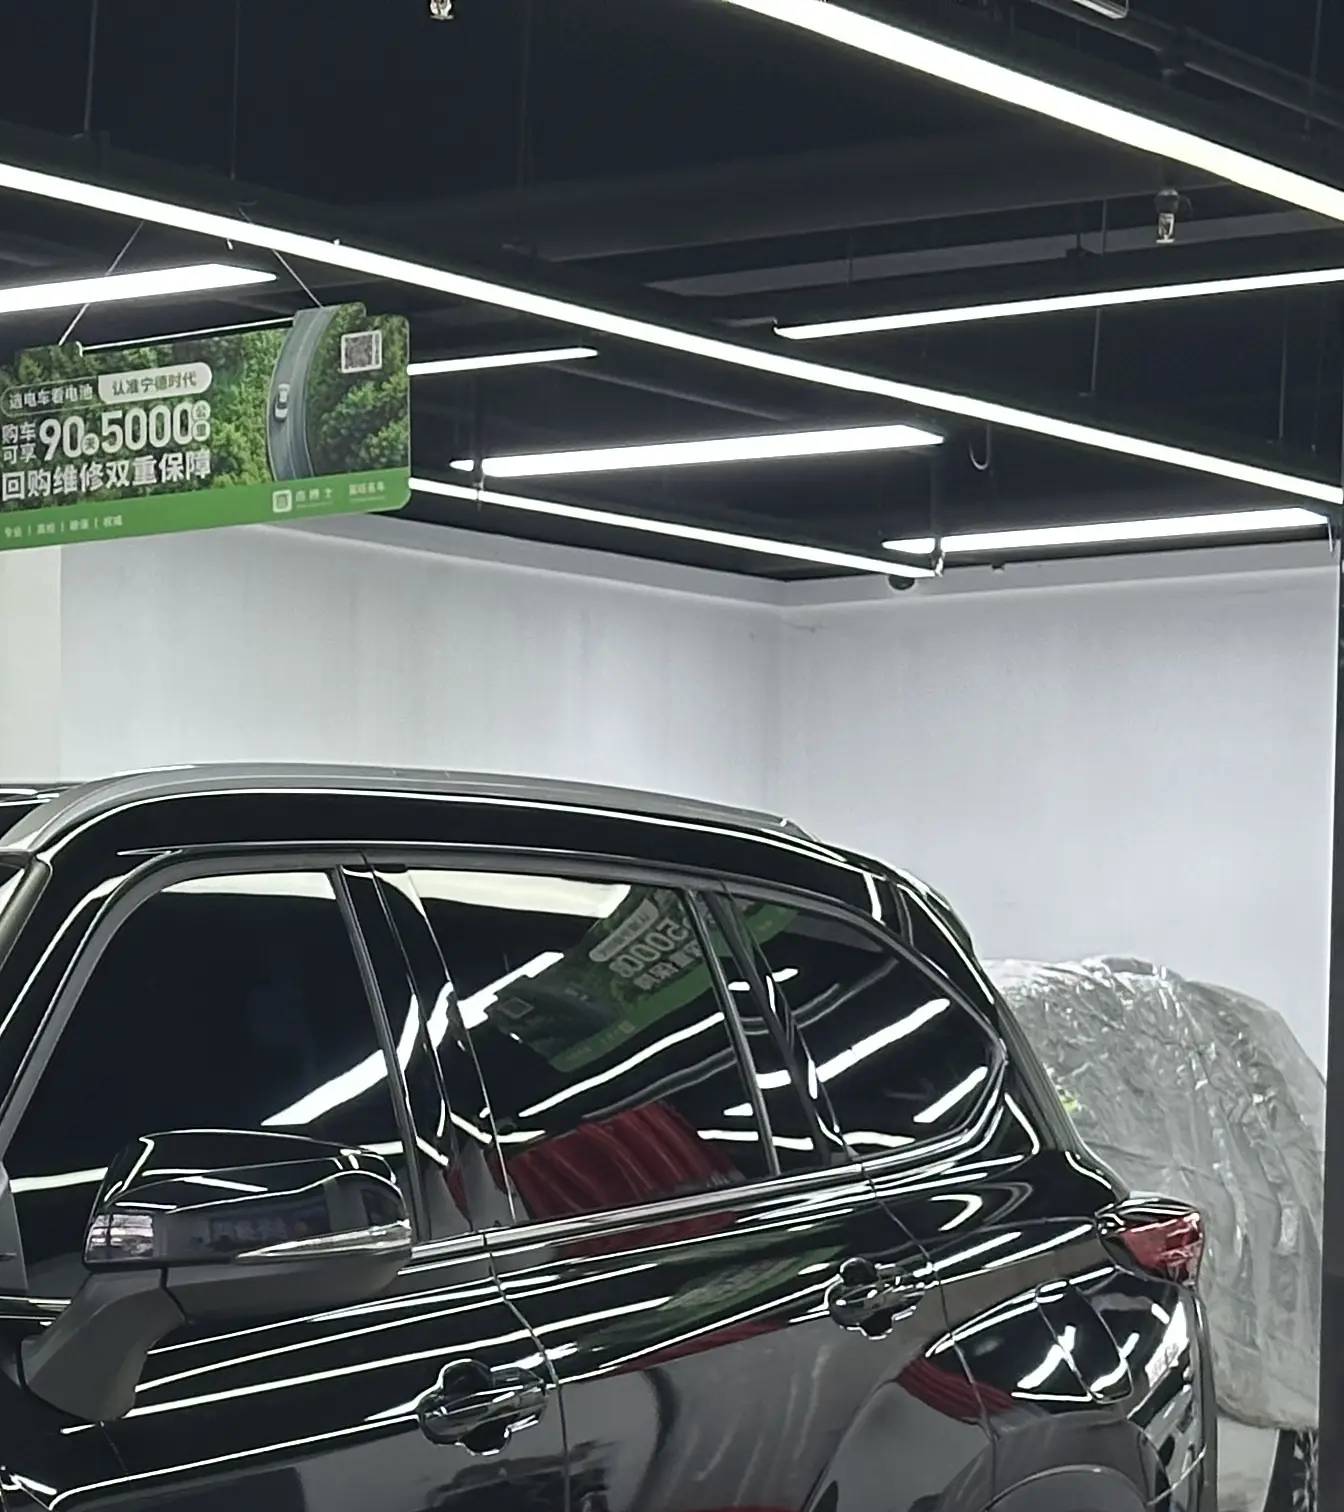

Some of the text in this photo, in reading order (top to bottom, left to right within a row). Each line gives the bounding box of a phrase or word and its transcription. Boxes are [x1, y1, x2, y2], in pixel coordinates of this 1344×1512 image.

[2, 448, 211, 502] 回购维修双重保障
